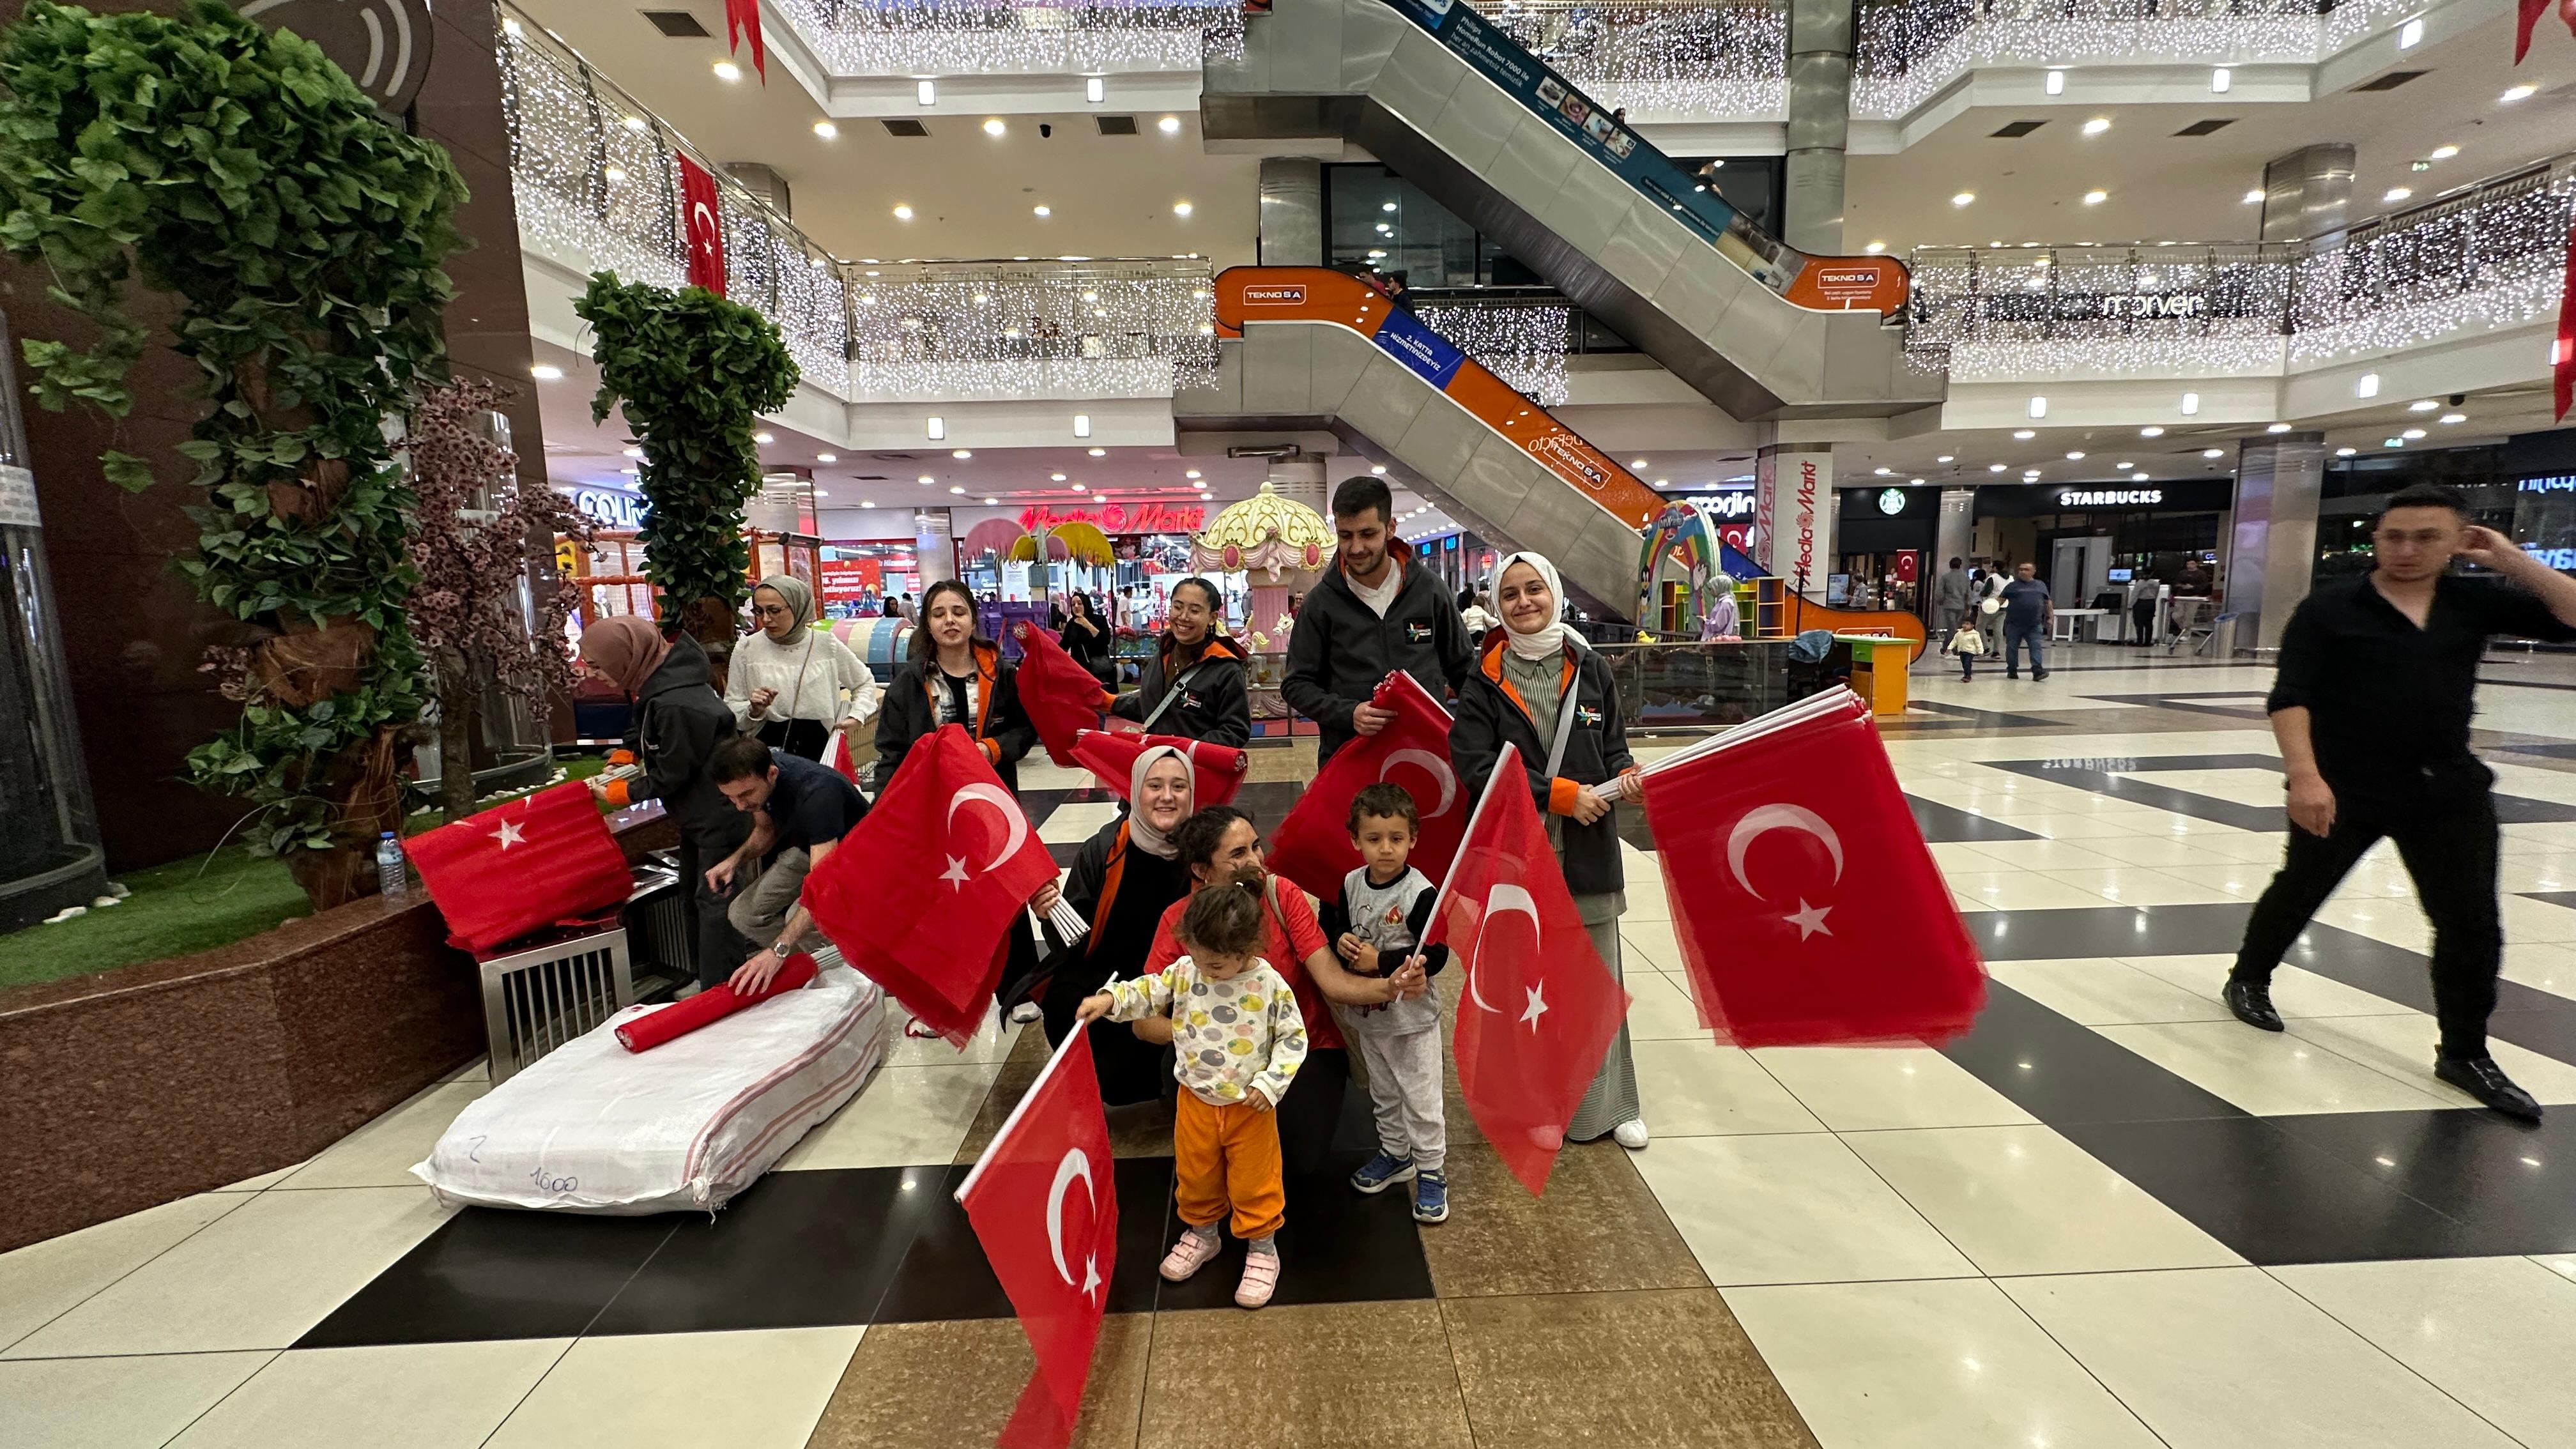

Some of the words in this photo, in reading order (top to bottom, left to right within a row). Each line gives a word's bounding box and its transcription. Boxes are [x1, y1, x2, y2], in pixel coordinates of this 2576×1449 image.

[1460, 16, 1482, 35] Philips
[1450, 32, 1463, 43] her
[1455, 24, 1487, 50] HomeRun
[1486, 47, 1506, 64] Robot
[1506, 60, 1521, 75] 7000
[1413, 339, 1433, 356] KATTA
[1797, 459, 1816, 514] Markt
[2060, 490, 2162, 505] STARBUCKS
[1123, 503, 1206, 532] Markt
[1792, 527, 1813, 586] Media
[822, 585, 862, 594] utluyoruz!
